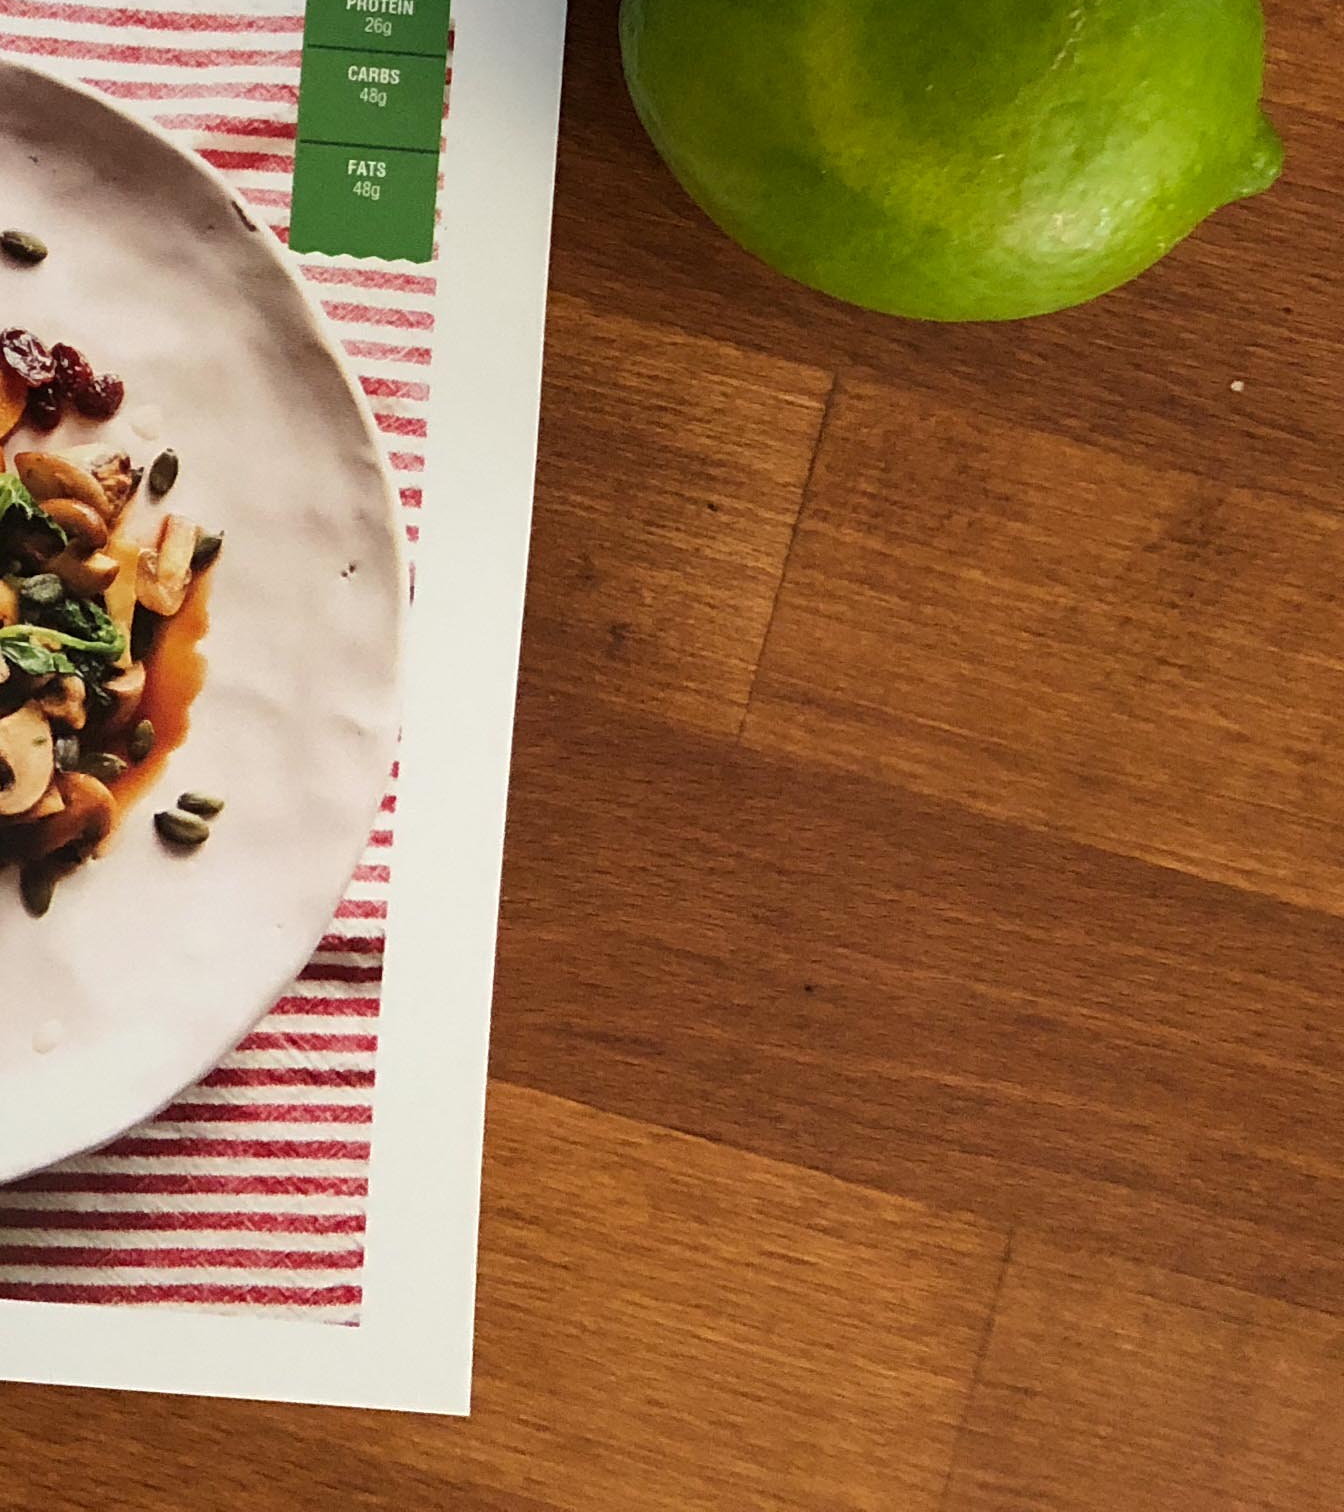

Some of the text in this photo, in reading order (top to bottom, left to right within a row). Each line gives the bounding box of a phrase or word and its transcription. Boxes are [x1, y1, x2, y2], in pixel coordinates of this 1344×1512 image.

[364, 16, 392, 37] 26g
[347, 65, 401, 85] CARBS
[359, 87, 387, 107] 48g
[347, 159, 387, 178] FATS
[352, 180, 381, 201] 48g
